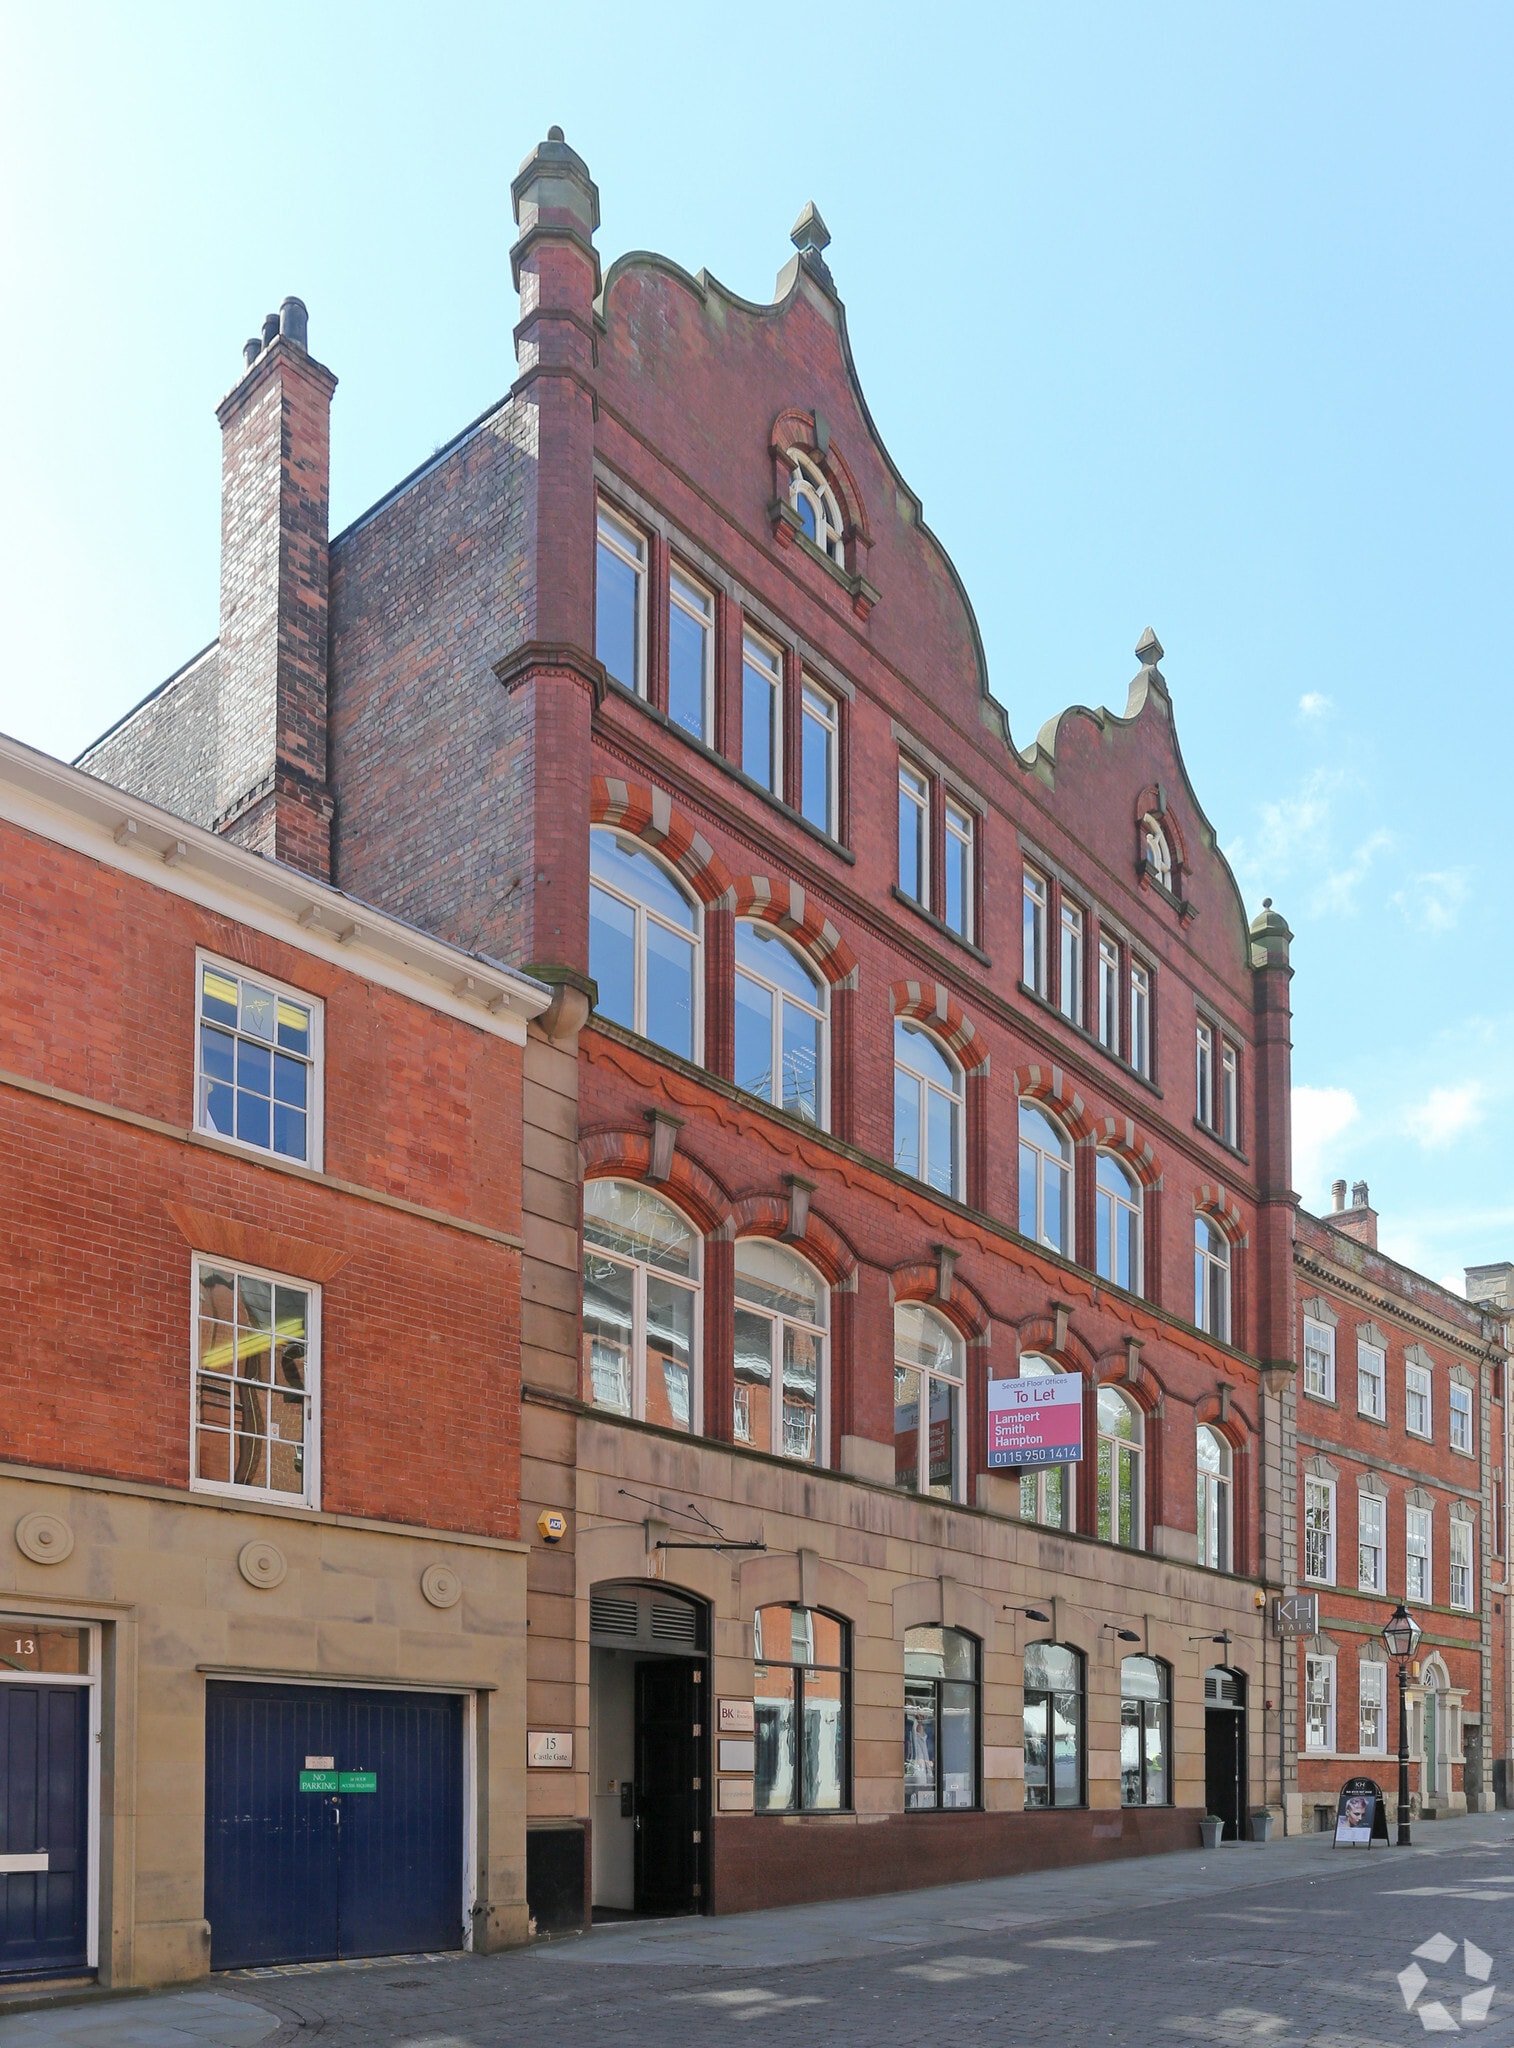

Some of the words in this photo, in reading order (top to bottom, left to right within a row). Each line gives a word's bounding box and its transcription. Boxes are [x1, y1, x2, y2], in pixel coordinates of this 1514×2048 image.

[1002, 1381, 1025, 1390] Second
[1045, 1378, 1068, 1386] Offices
[1014, 1390, 1029, 1403] To
[1034, 1388, 1055, 1402] Let
[995, 1411, 1040, 1425] Lambert
[995, 1424, 1026, 1436] Smith
[995, 1435, 1043, 1447] Hampton
[995, 1451, 1022, 1464] 0115
[1025, 1449, 1046, 1461] 950
[1050, 1447, 1077, 1459] 1414
[1277, 1598, 1312, 1621] KH
[1277, 1622, 1312, 1632] HAIR
[14, 1639, 35, 1655] 13
[722, 1707, 735, 1719] BK
[546, 1737, 557, 1750] 15
[533, 1753, 552, 1761] Castle
[553, 1753, 568, 1761] Gate
[313, 1773, 327, 1782] NO
[302, 1782, 336, 1790] PARKING
